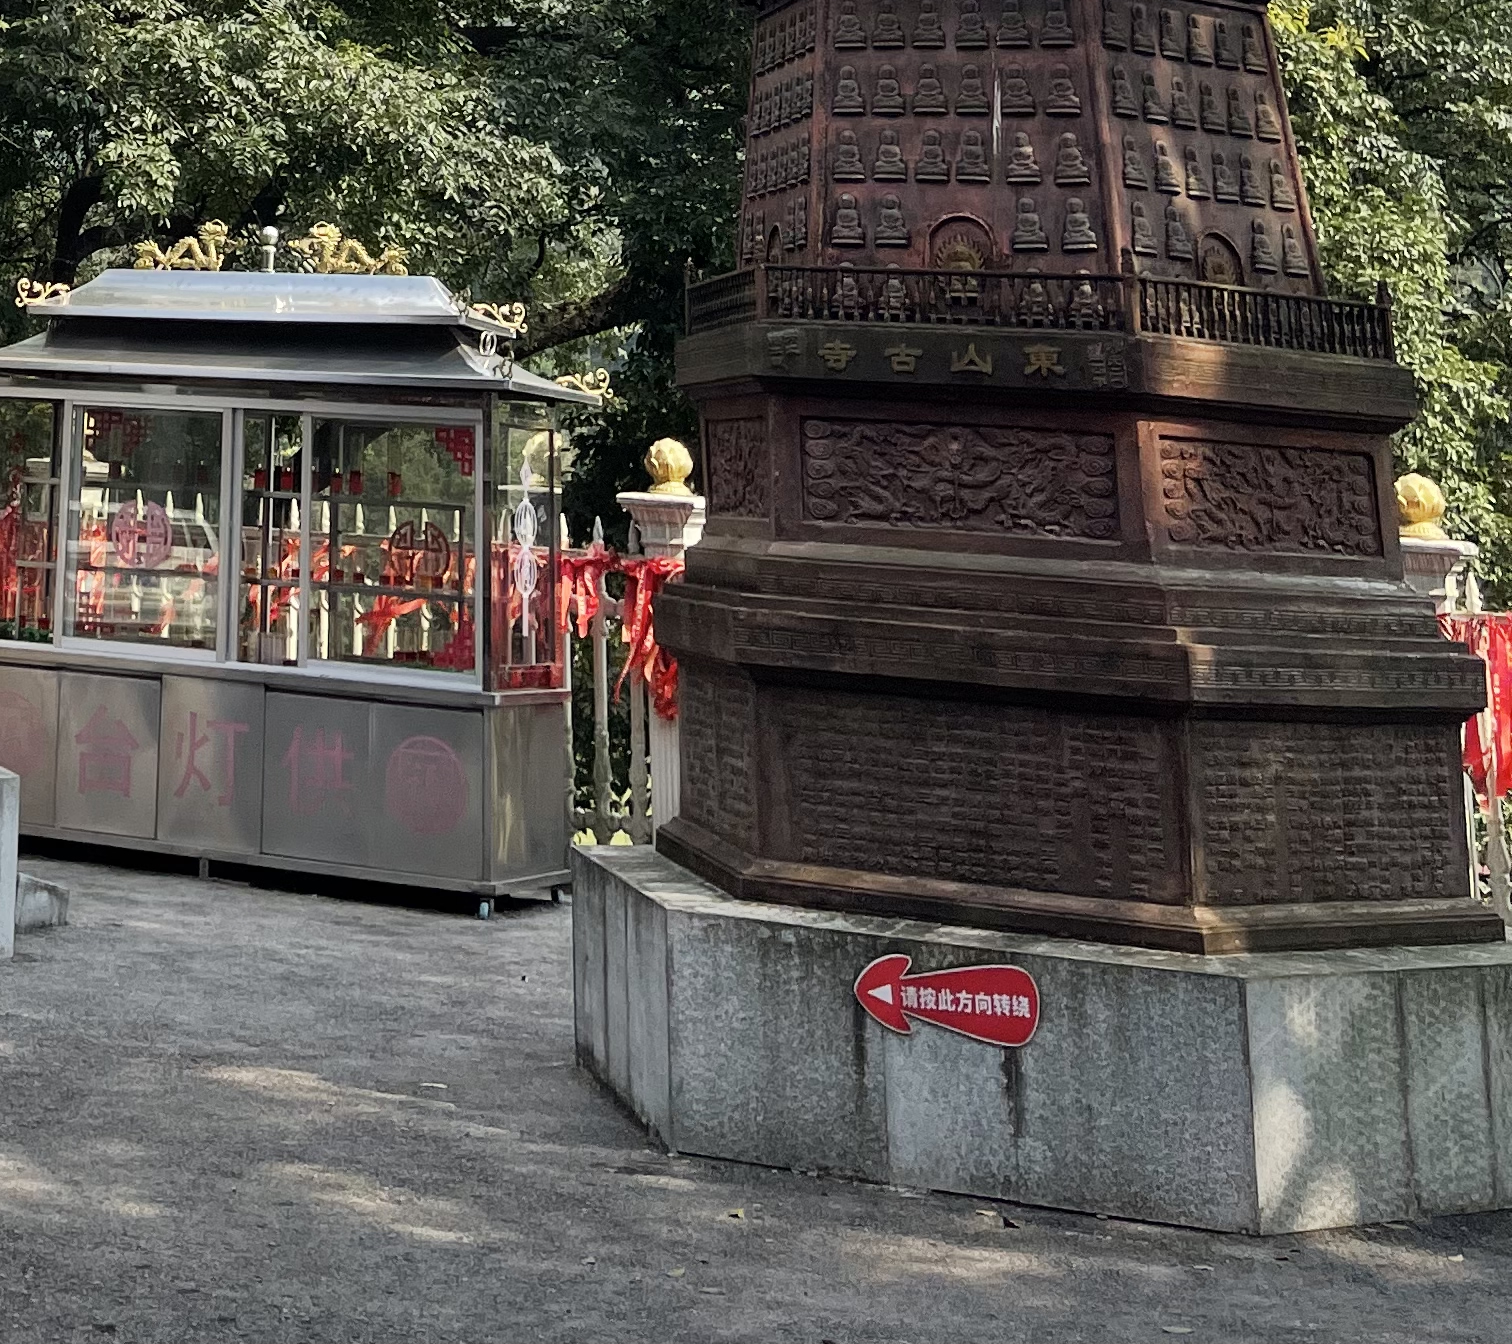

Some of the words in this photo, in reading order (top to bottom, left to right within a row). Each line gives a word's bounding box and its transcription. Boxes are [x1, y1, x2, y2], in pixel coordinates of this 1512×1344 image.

[818, 339, 1066, 379] 東山古寺
[899, 985, 1031, 1019] 请按此方向转绕
